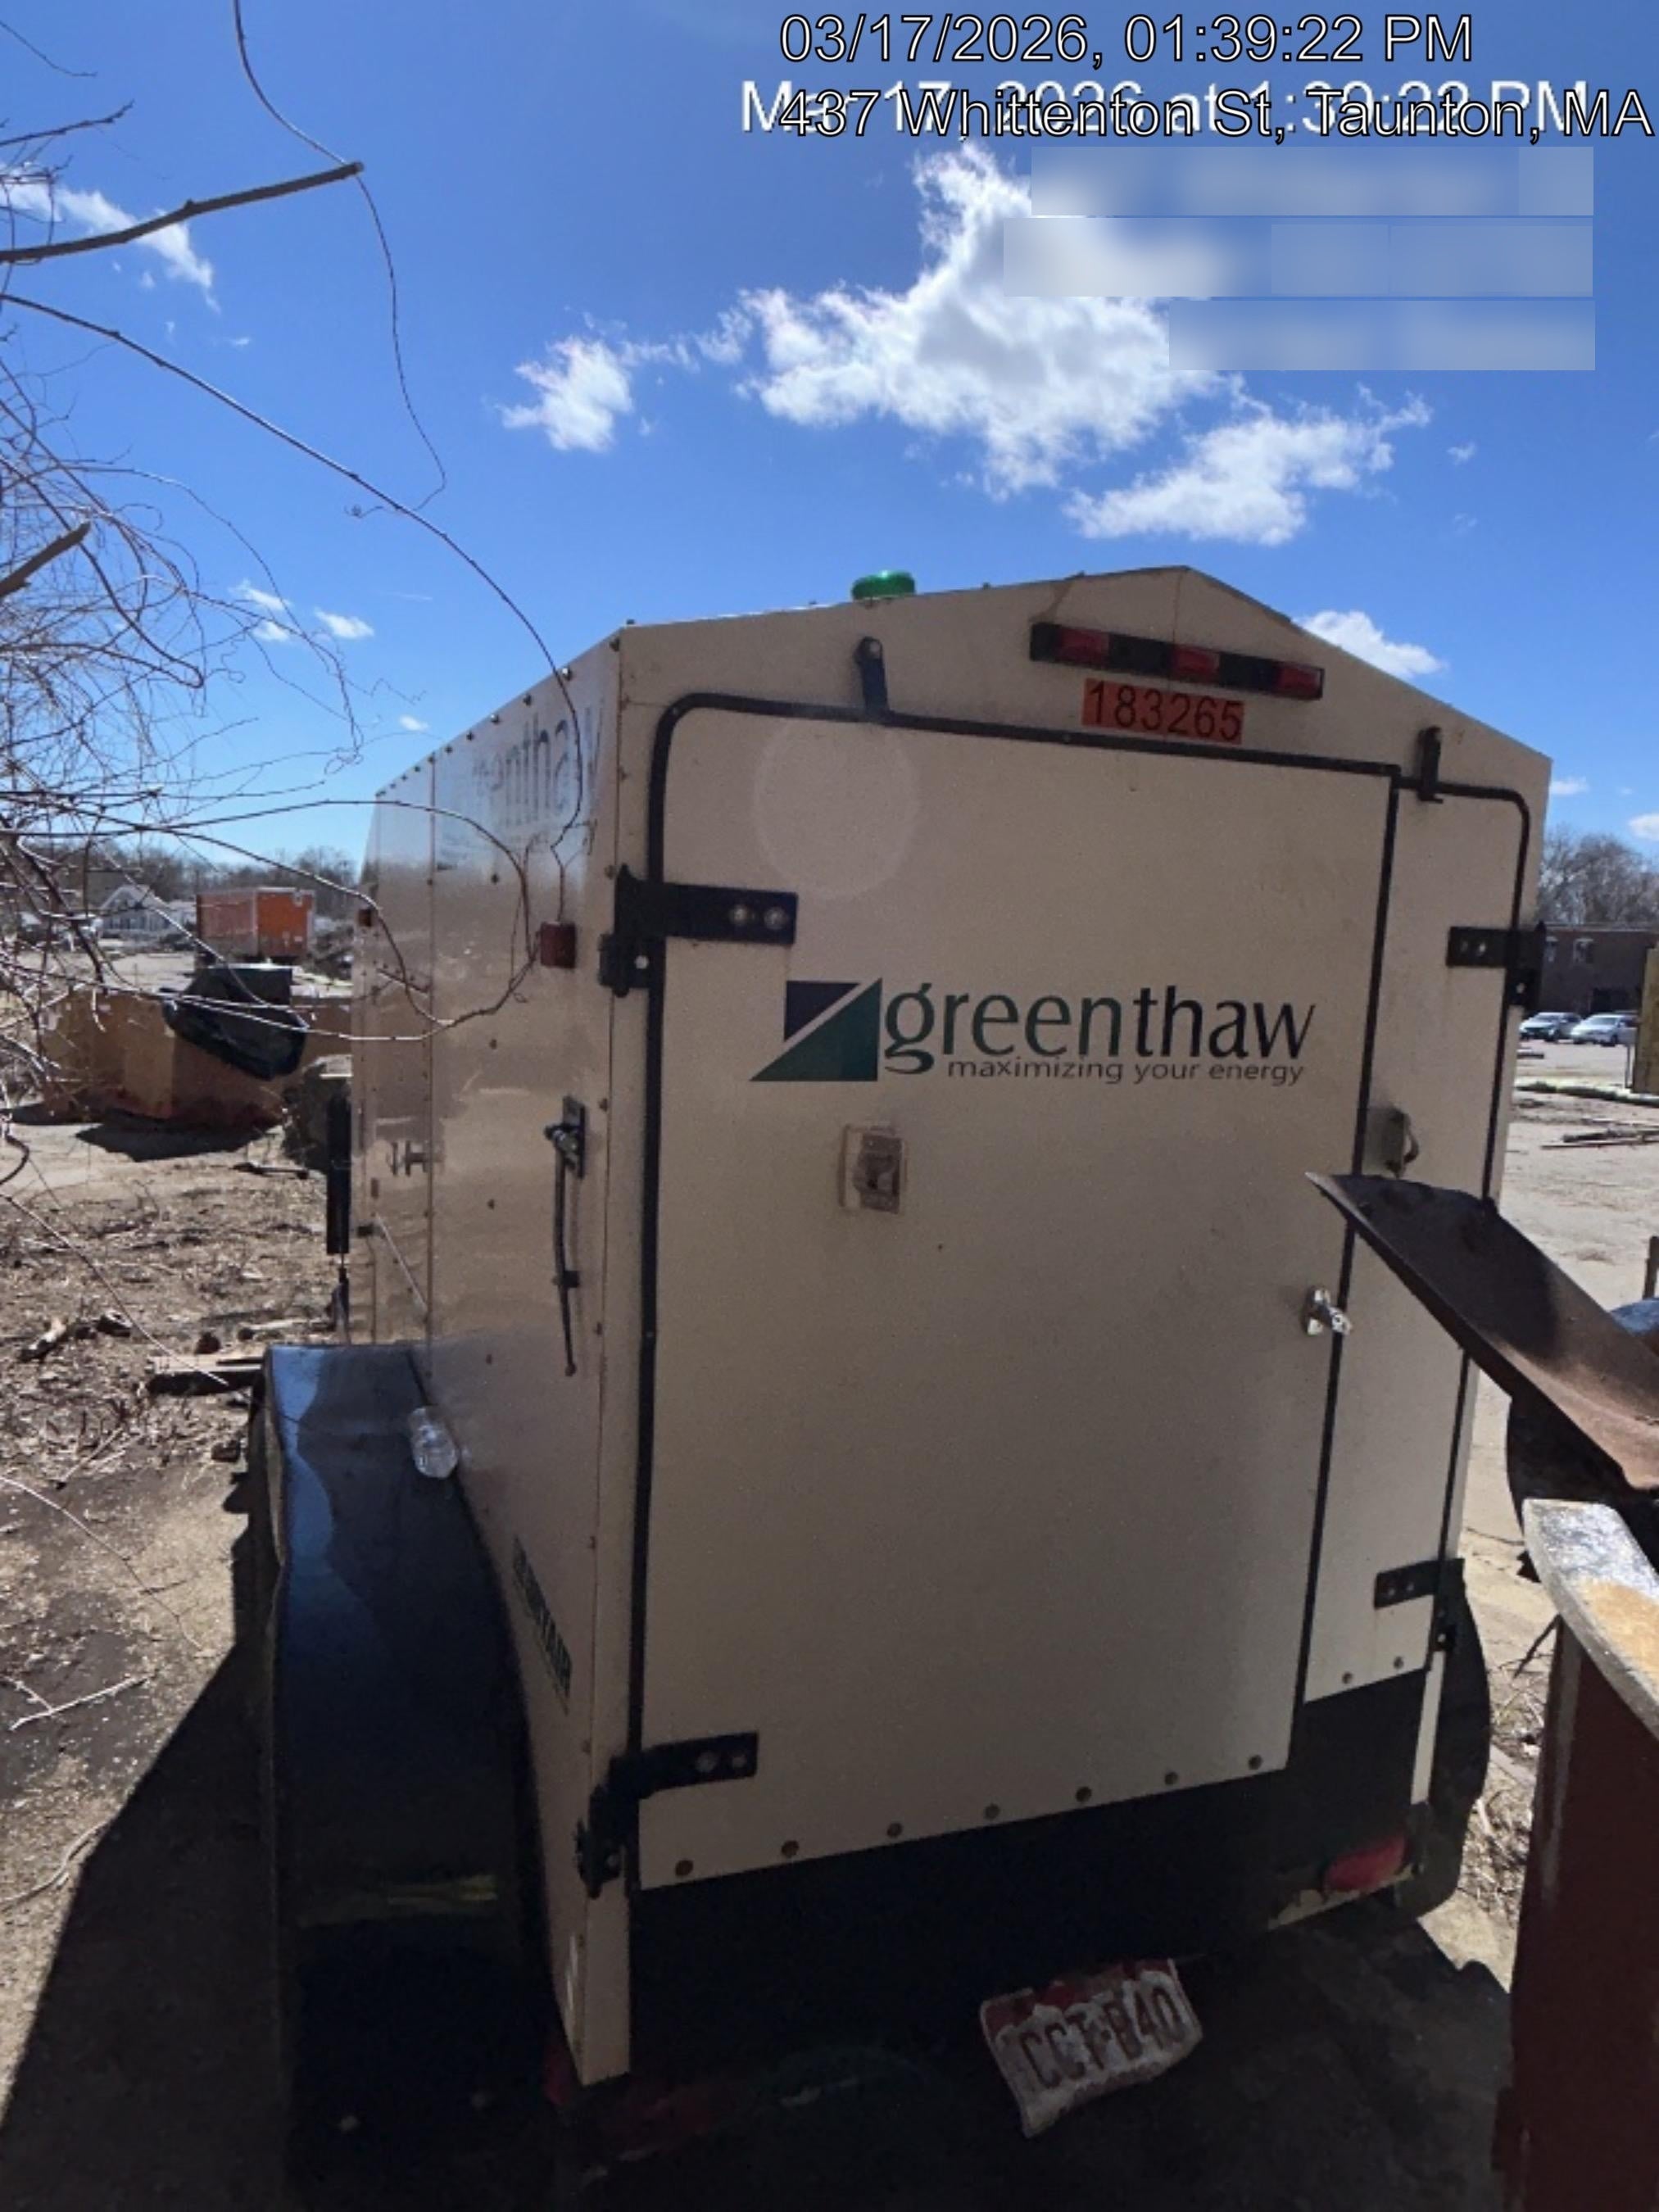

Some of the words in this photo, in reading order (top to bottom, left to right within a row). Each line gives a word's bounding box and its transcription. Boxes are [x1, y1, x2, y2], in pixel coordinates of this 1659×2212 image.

[1087, 679, 1244, 741] 183265
[883, 982, 1317, 1075] greenthaw
[947, 1056, 1123, 1085] maximizing
[1132, 1063, 1199, 1084] your
[1208, 1063, 1304, 1087] energy
